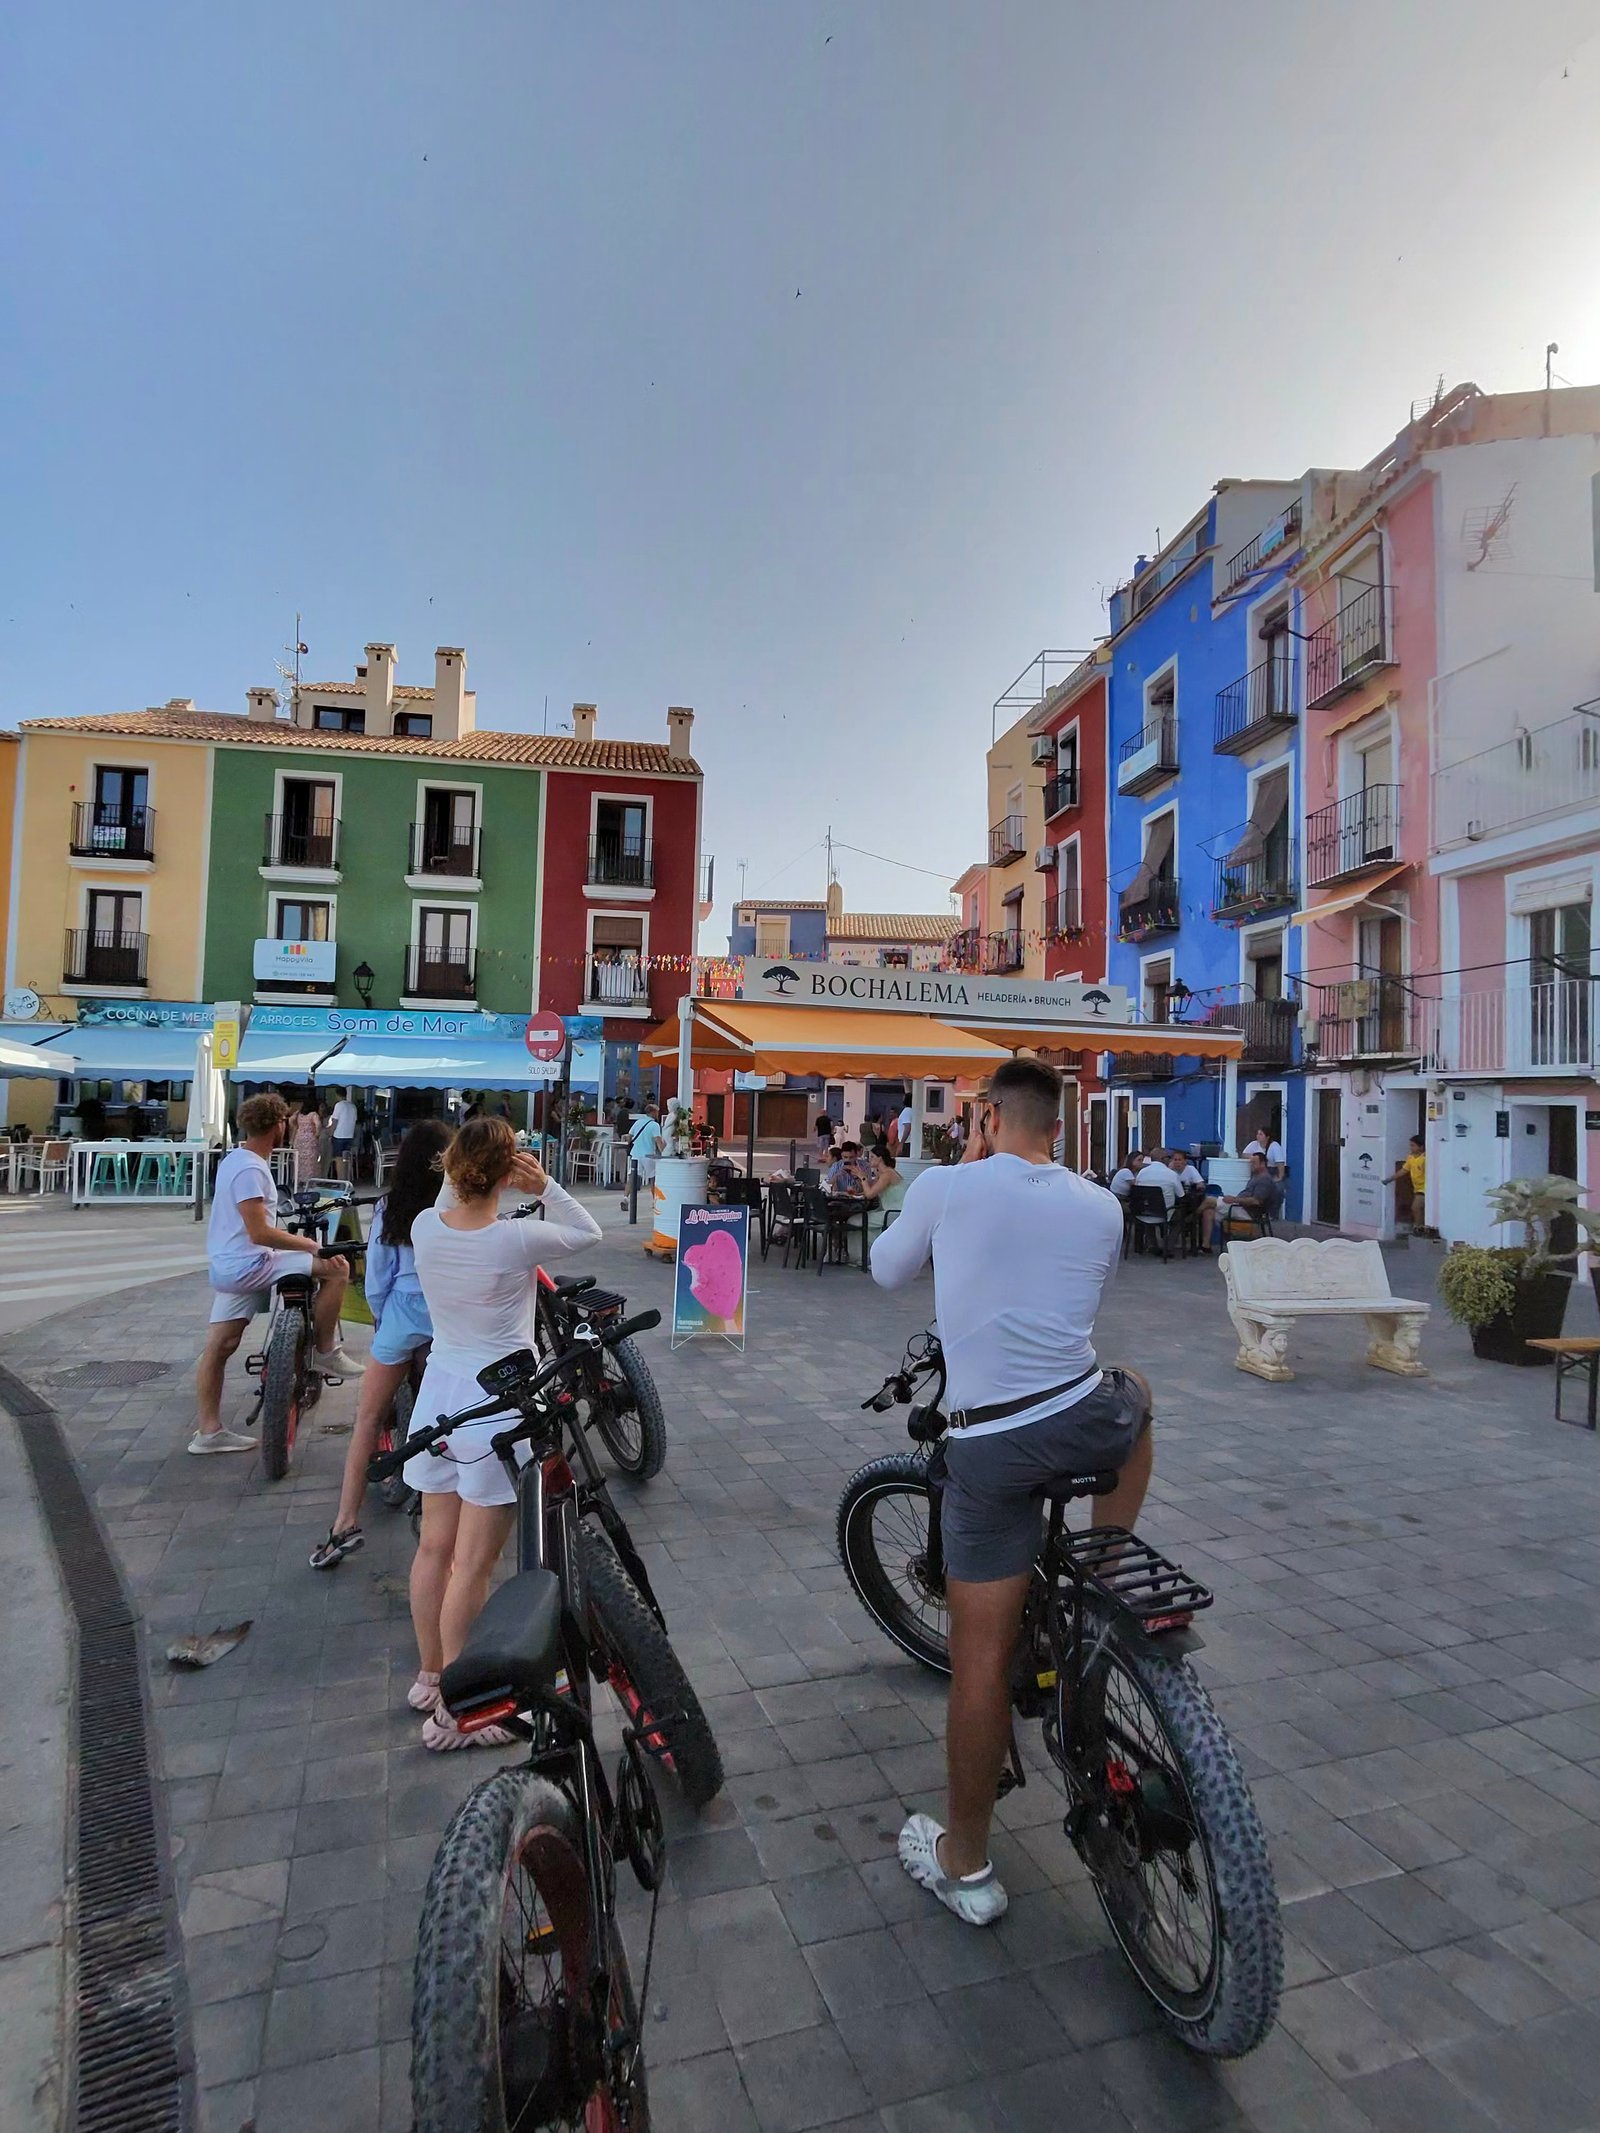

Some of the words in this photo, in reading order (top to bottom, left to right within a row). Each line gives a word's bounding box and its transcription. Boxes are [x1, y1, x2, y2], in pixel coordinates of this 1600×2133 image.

[275, 955, 314, 964] HappyVila
[811, 974, 970, 1005] BOCHALEMA
[977, 992, 1027, 1004] HELADERÍA
[1034, 995, 1071, 1007] BRUNCH
[106, 1009, 158, 1021] COCINA
[160, 1011, 179, 1021] DE
[182, 1011, 216, 1022] MERC
[249, 1014, 257, 1024] Y
[259, 1014, 318, 1027] ARROCES
[327, 1013, 378, 1032] Som
[386, 1015, 415, 1033] de
[422, 1016, 469, 1034] Mar
[528, 1066, 540, 1075] SOLO
[541, 1066, 557, 1075] SALIDA
